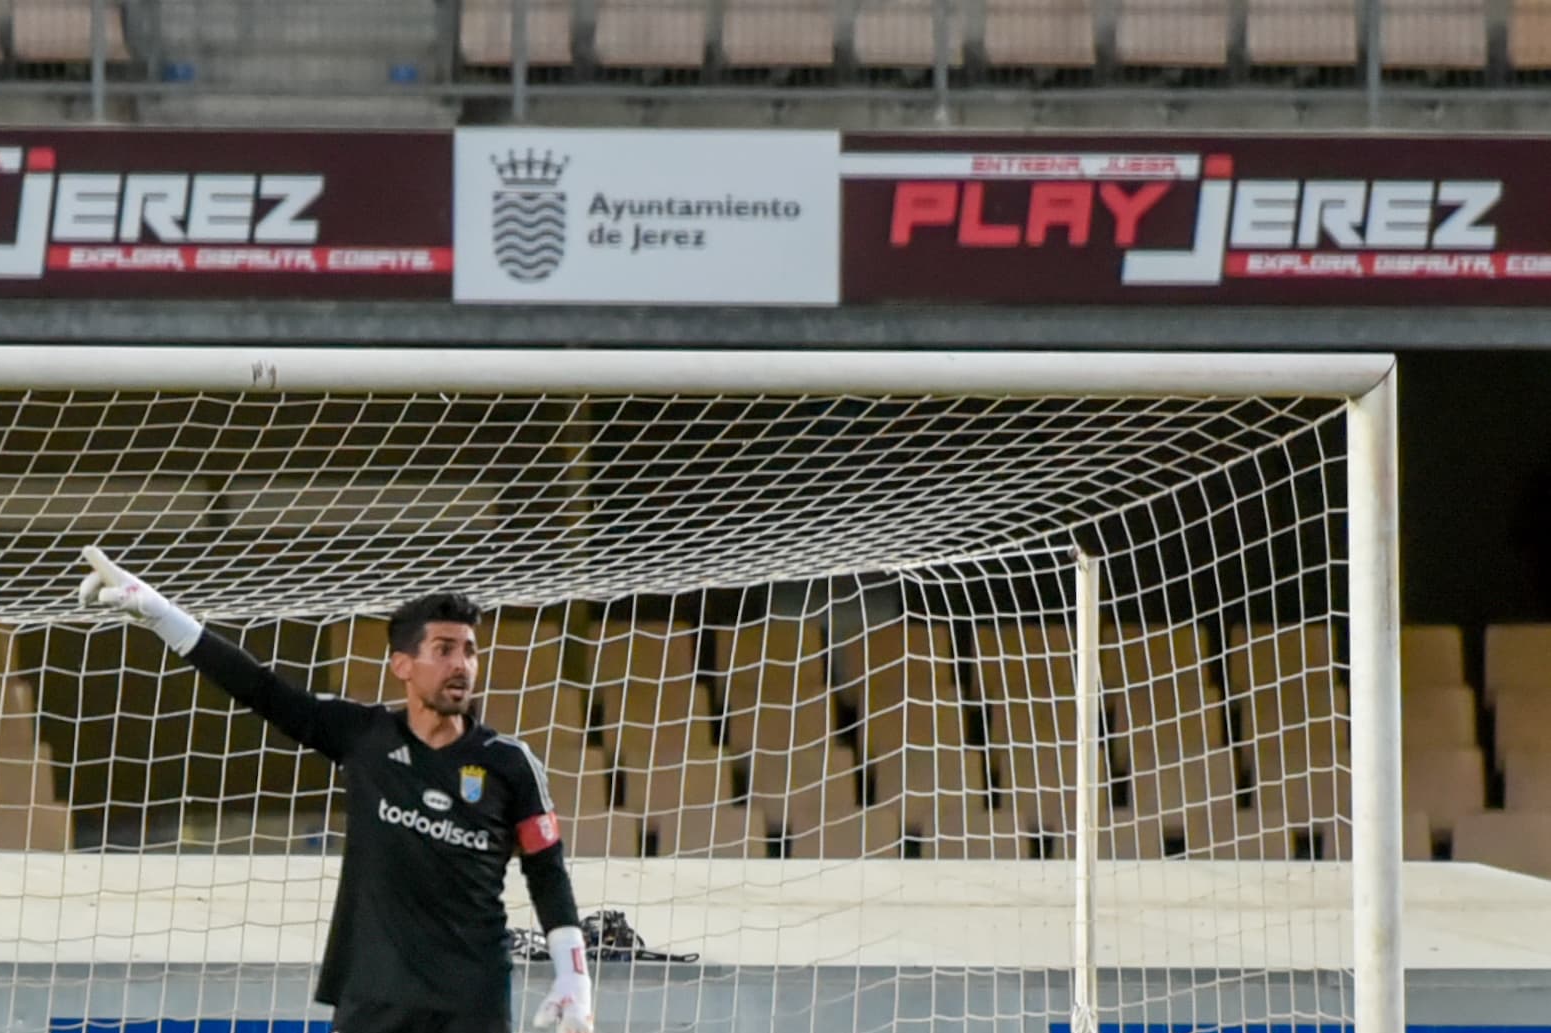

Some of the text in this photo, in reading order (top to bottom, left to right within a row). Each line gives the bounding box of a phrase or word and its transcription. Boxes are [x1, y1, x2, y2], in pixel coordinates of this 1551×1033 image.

[588, 191, 803, 222] Ayuntamiento
[889, 180, 1173, 247] PLAY
[587, 223, 706, 254] de Jerez
[378, 798, 489, 851] tododisca
